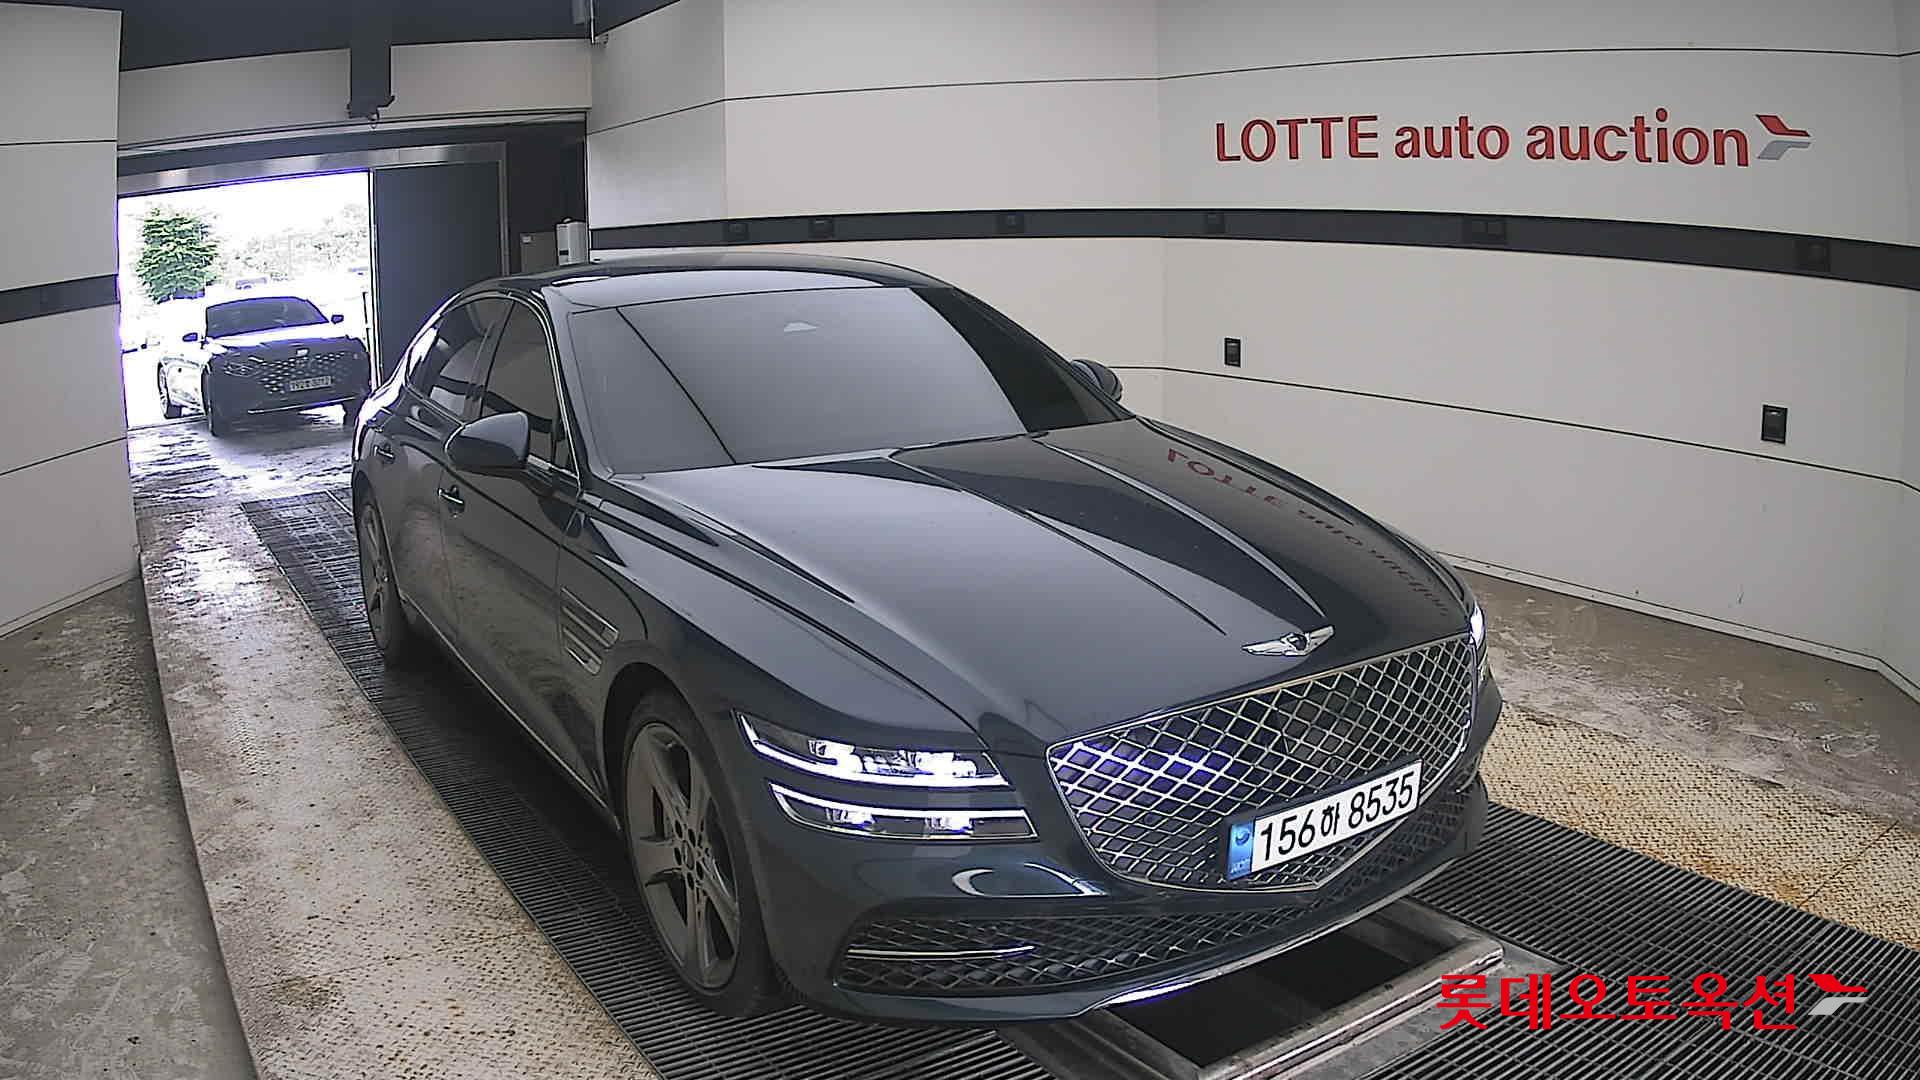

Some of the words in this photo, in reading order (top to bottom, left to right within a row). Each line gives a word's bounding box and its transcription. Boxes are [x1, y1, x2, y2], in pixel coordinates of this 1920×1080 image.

[1215, 115, 1380, 162] LOTTE
[1394, 115, 1510, 160] auto
[1526, 107, 1749, 167] auction
[1261, 802, 1340, 861] 156하
[1348, 771, 1415, 829] 8535
